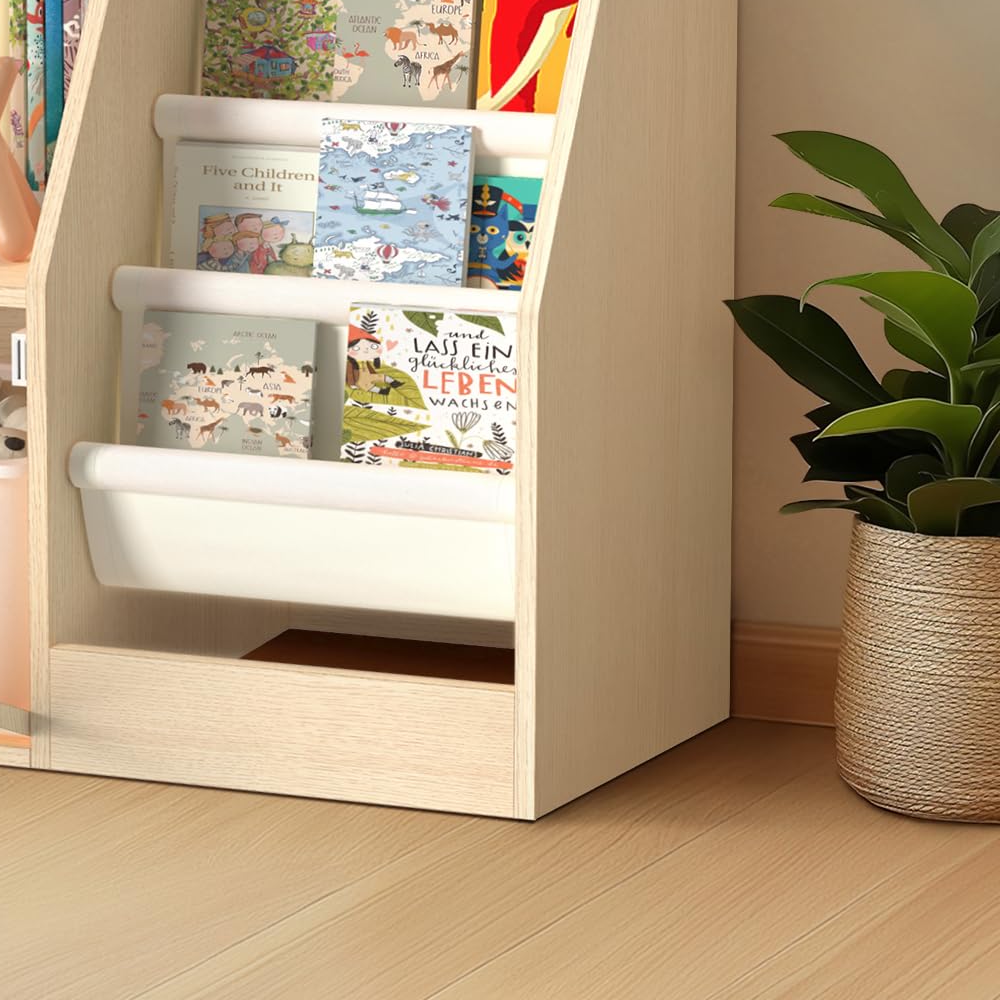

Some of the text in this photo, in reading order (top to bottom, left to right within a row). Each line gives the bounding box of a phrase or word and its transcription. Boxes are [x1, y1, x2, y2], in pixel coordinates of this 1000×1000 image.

[431, 4, 462, 15] EUROPE
[348, 15, 381, 24] ATLANTIC
[352, 25, 377, 33] OCEAN
[414, 51, 440, 60] AFRICA
[203, 165, 315, 181] Five Children
[233, 181, 282, 192] and It
[446, 330, 490, 340] und
[413, 338, 459, 356] LASS
[263, 382, 282, 391] ASIA
[423, 369, 517, 396] LEBEN
[399, 441, 425, 450] JULIA
